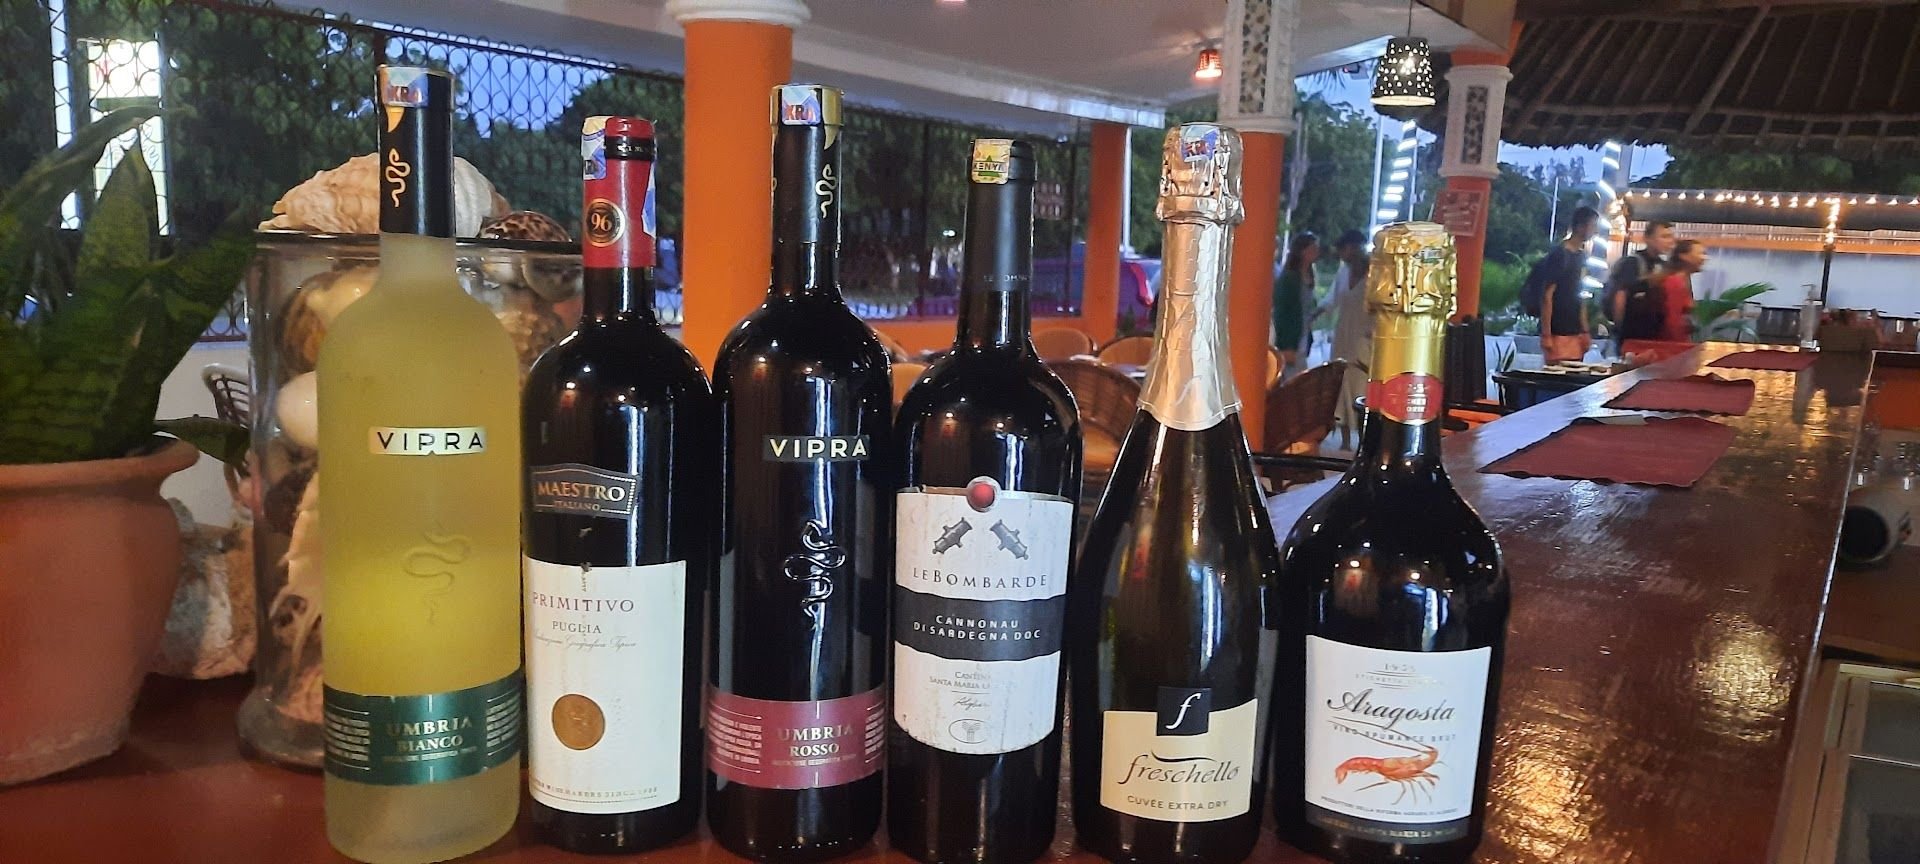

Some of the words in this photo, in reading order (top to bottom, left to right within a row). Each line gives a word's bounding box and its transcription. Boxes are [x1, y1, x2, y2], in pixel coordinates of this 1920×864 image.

[591, 213, 612, 232] 96
[377, 431, 483, 451] VIPRA
[769, 438, 867, 459] VIPRA
[537, 481, 626, 502] MAESTRO
[553, 500, 601, 512] ITALIANO
[532, 591, 635, 613] PRIMITIVO
[552, 620, 602, 634] PUGLIA
[935, 615, 1019, 629] CANNONAU
[1013, 629, 1041, 641] DOC
[1165, 692, 1202, 730] f
[1327, 688, 1456, 730] Aragosta
[386, 717, 473, 737] UMBRIA
[776, 724, 855, 742] UMBRIA
[397, 735, 464, 753] BIANCO
[790, 743, 840, 757] ROSSO
[1117, 754, 1240, 785] freschello
[1168, 802, 1204, 810] EXTRA
[1207, 799, 1229, 810] DRY
